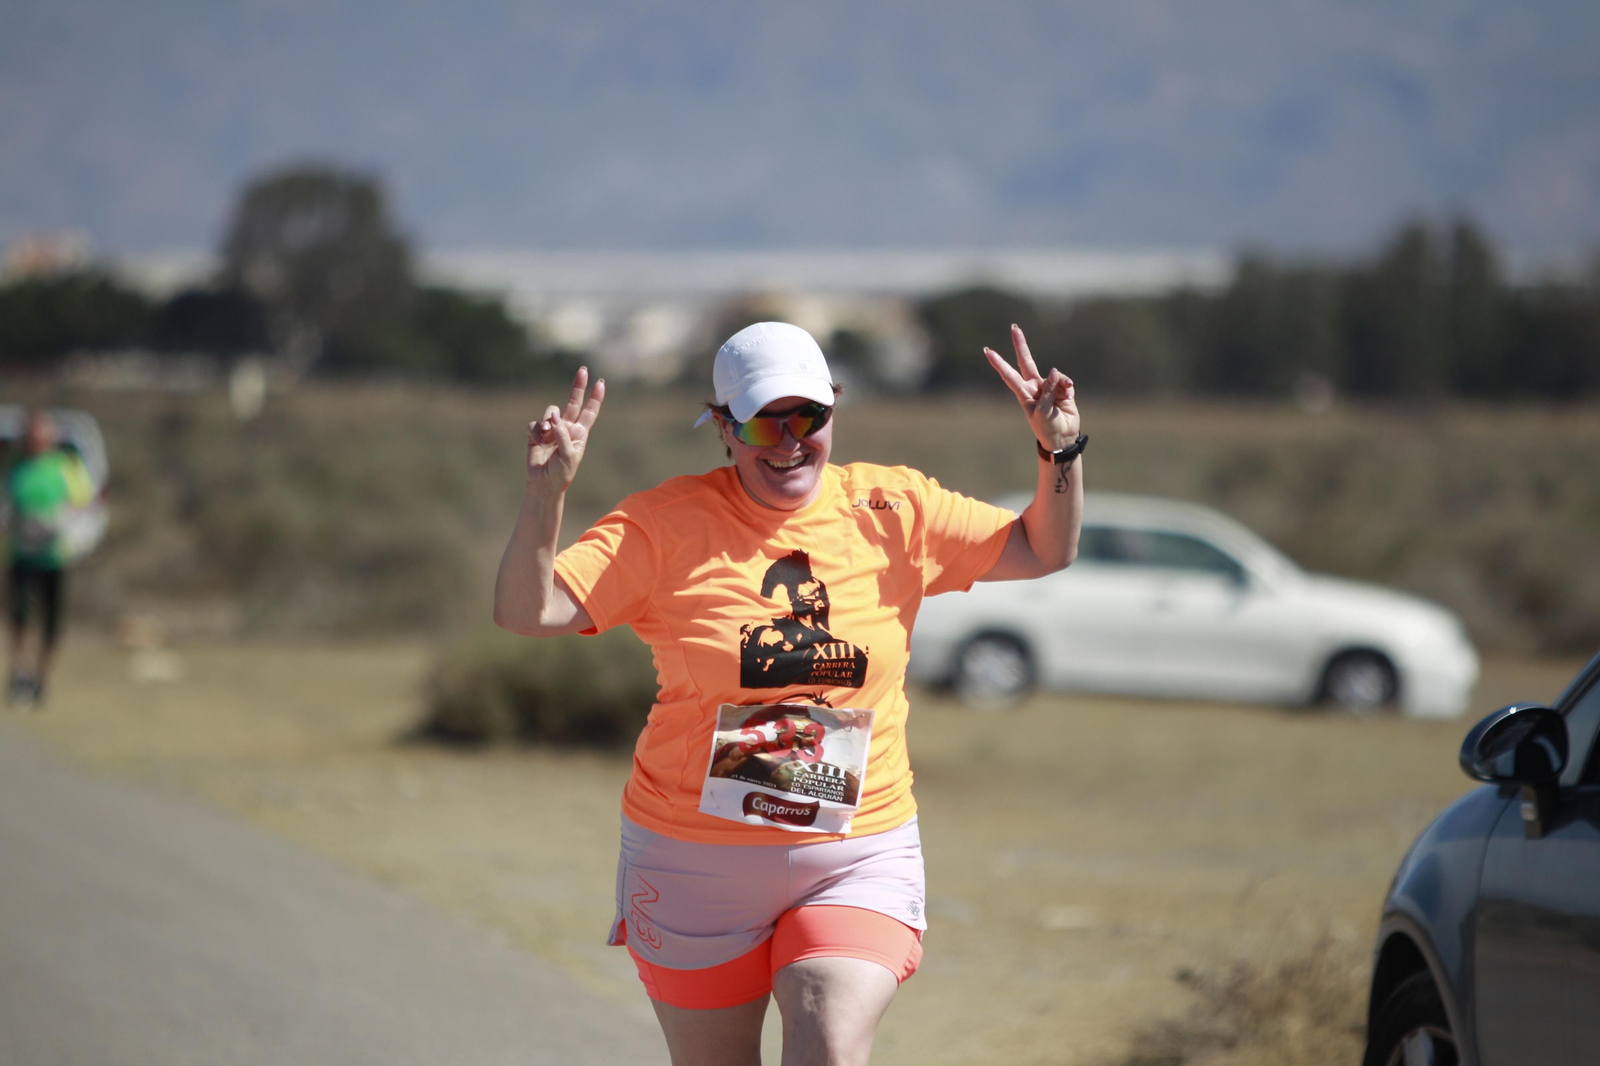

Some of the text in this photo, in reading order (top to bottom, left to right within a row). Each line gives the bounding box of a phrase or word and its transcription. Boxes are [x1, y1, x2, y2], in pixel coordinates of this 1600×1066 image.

[813, 642, 855, 660] XIII
[813, 661, 856, 670] CARRERA
[794, 770, 847, 786] CARRERA
[795, 760, 846, 780] XIII
[793, 777, 845, 791] POPULAR
